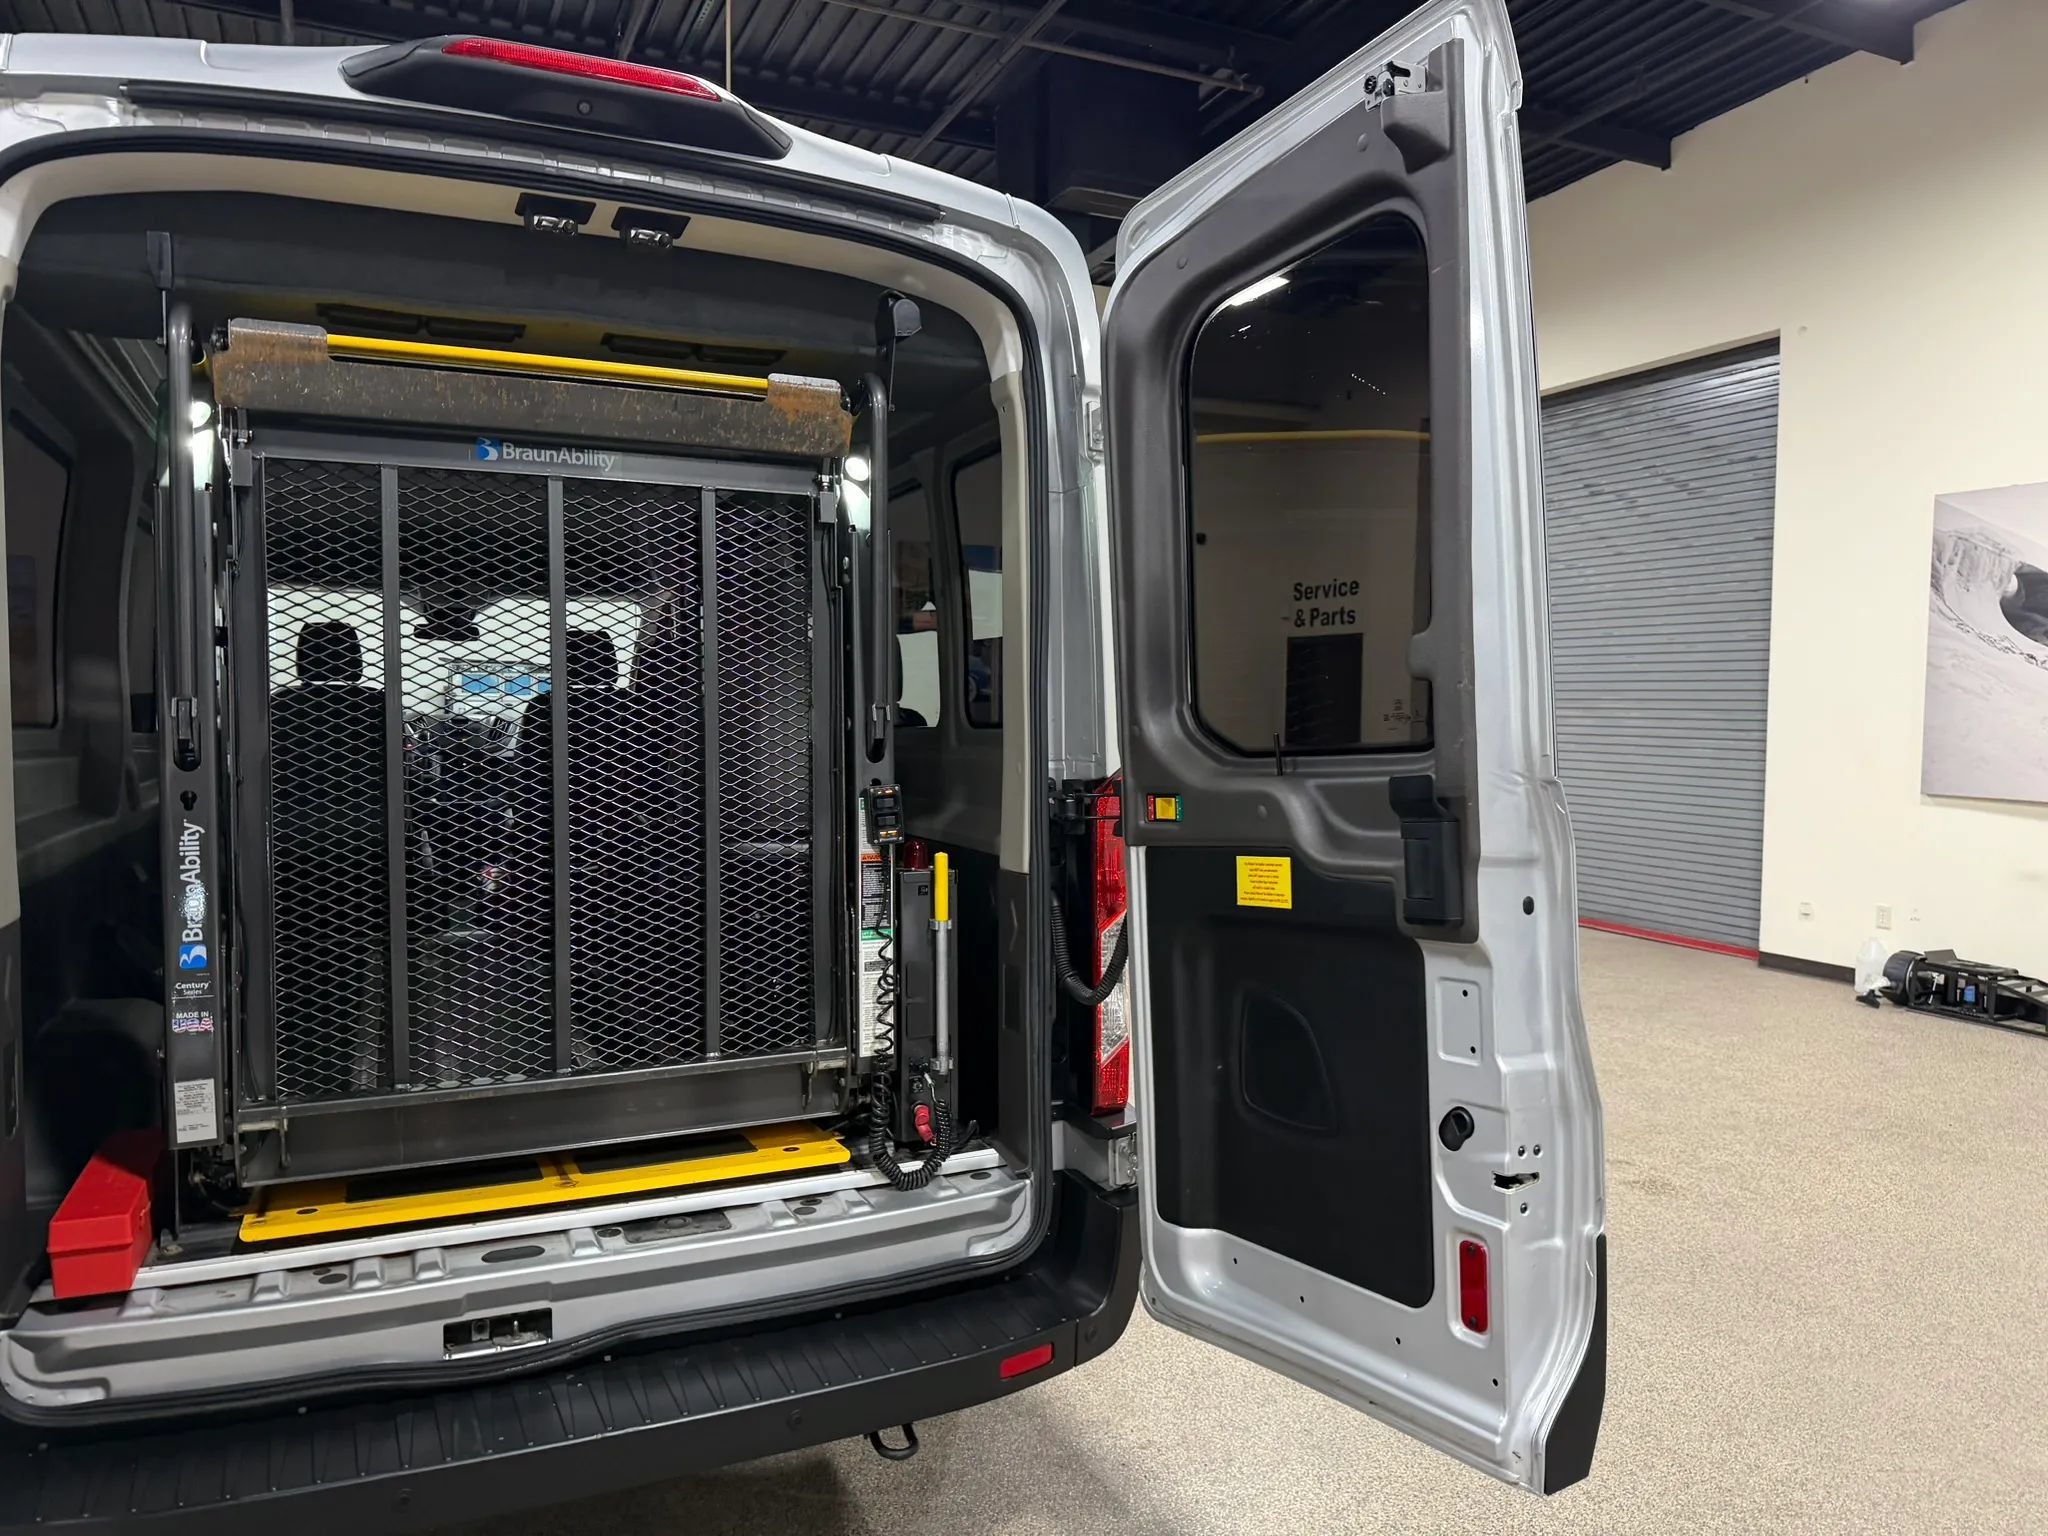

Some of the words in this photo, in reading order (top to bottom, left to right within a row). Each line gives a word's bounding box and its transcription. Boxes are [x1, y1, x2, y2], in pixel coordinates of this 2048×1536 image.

[502, 442, 615, 472] BraunAbility
[1293, 579, 1360, 601] Service
[1294, 609, 1306, 628] &
[1309, 607, 1356, 627] Parts
[175, 982, 210, 990] Century
[175, 1011, 200, 1019] MADE
[172, 1018, 214, 1033] USA
